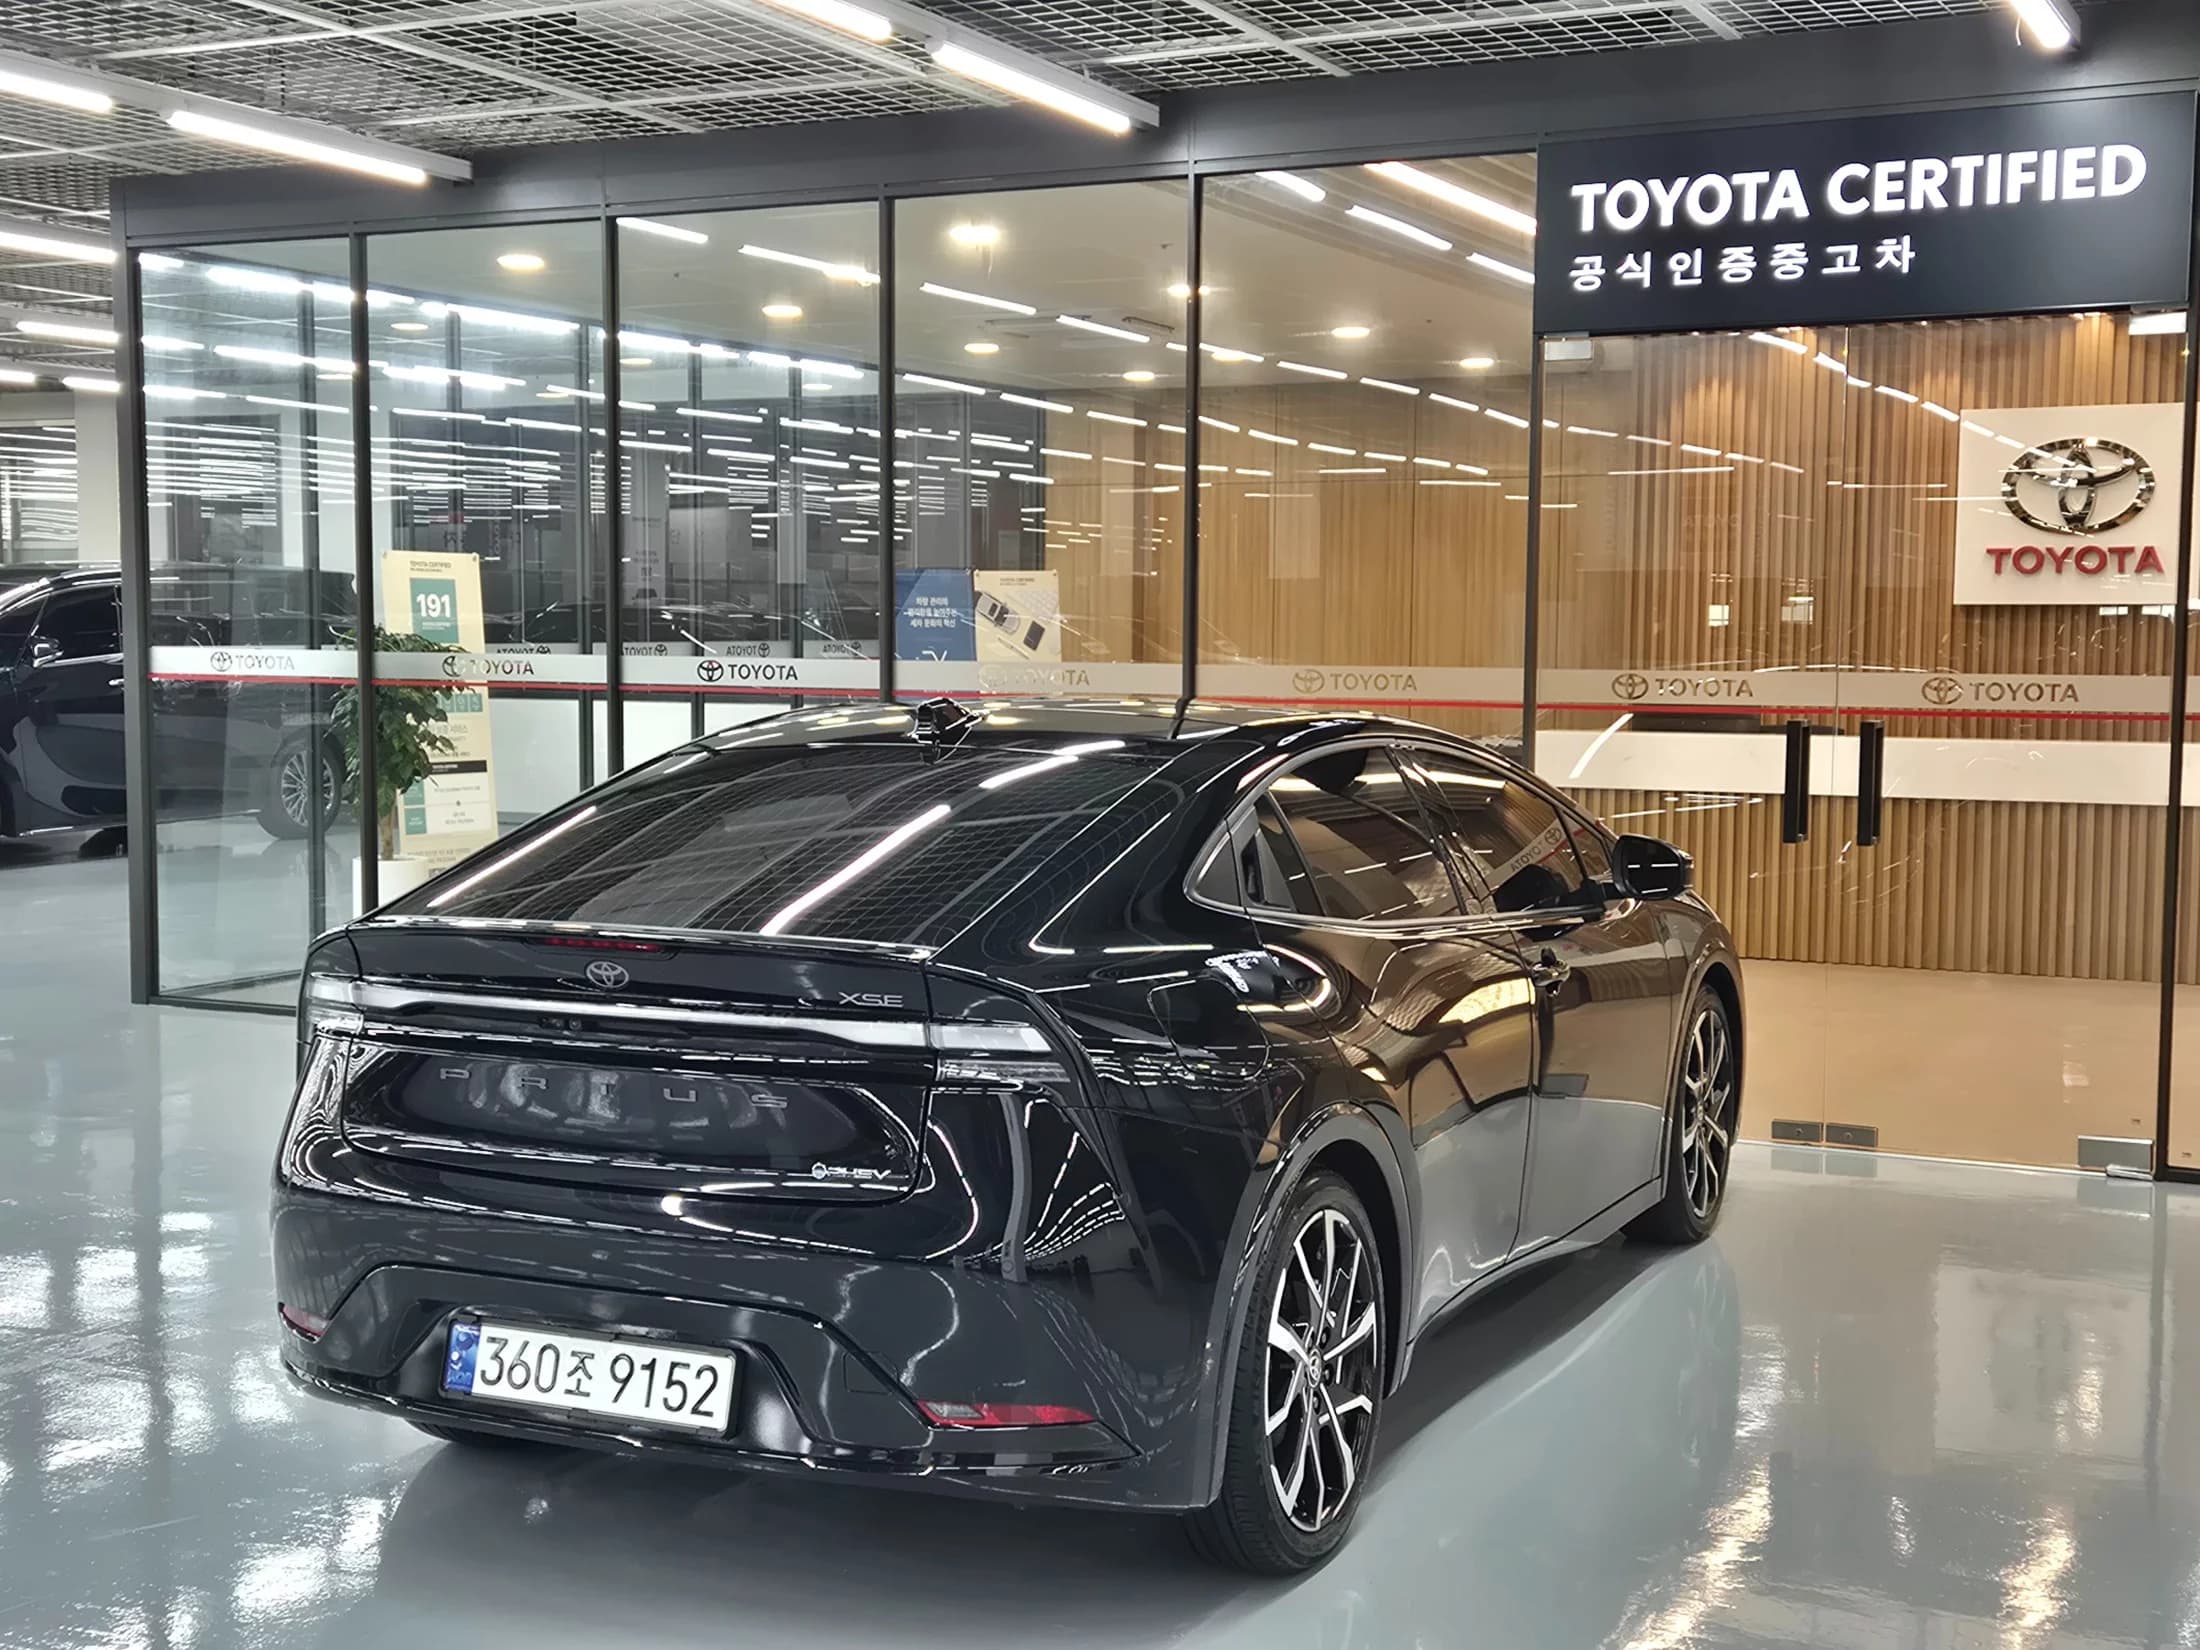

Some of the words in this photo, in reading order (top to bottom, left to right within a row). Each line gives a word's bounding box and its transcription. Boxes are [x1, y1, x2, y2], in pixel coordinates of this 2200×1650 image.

[1571, 168, 1810, 232] TOYOTA
[1827, 143, 2147, 215] CERTIFIED
[1569, 235, 1916, 291] 공식인증중고차
[1986, 546, 2164, 576] TOYOTA
[416, 593, 450, 618] 191
[235, 654, 296, 671] TOYOTA
[728, 664, 798, 681] TOYOTA
[1330, 673, 1417, 691] TOYOTA
[1655, 678, 1753, 698] TOYOTA
[1969, 682, 2079, 703] TOYOTA
[838, 991, 904, 1008] XSE
[440, 1067, 788, 1109] PRIUS
[828, 1167, 892, 1180] PHEV
[609, 1353, 719, 1418] 9152
